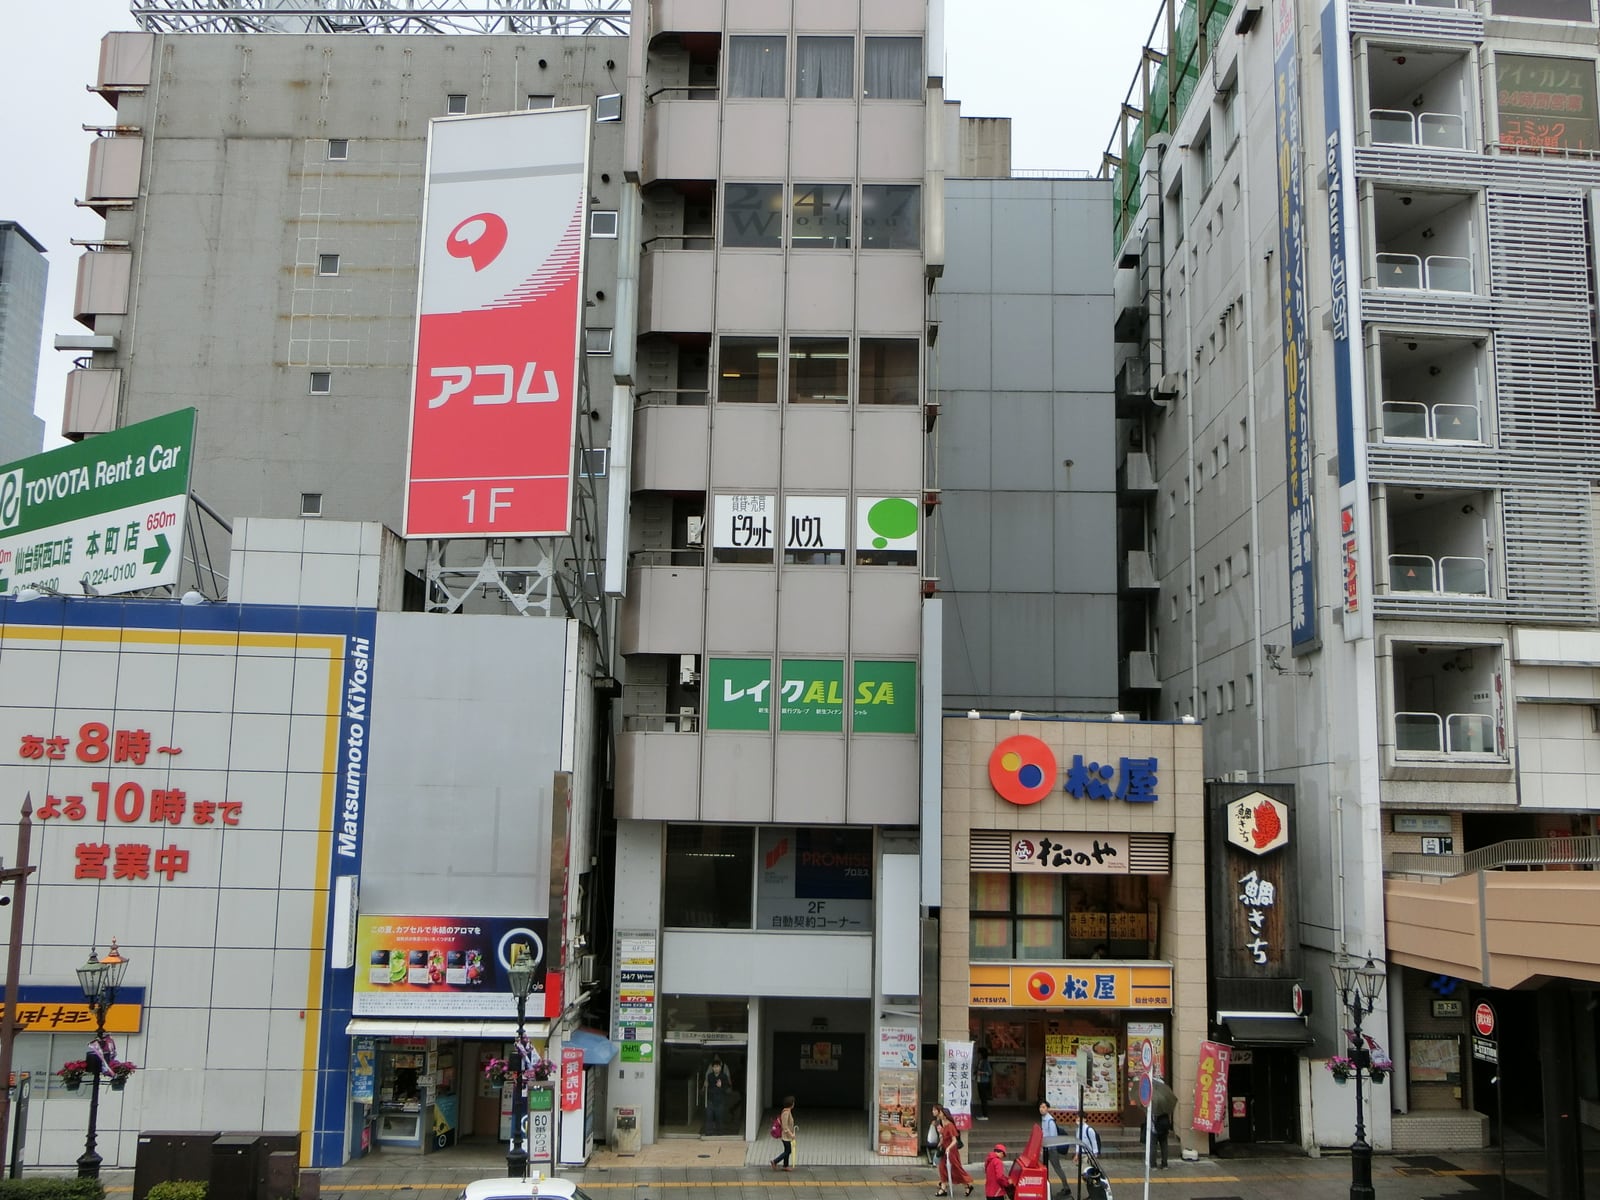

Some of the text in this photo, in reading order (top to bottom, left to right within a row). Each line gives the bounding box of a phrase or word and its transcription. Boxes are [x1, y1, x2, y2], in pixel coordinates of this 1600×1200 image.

[1498, 90, 1584, 111] 24時間営業
[1508, 120, 1566, 137] コミック
[1327, 130, 1339, 174] For
[1330, 254, 1348, 341] JUST
[428, 361, 560, 409] アコム
[25, 444, 181, 507] TOYOTA Rent a Car
[146, 511, 177, 531] 650m
[462, 487, 515, 524] 1F
[86, 520, 141, 560] 本町店
[731, 514, 824, 548] ピタット ハウス
[14, 535, 74, 576] 仙台駅西口店
[91, 561, 137, 586] 224-0100
[1347, 538, 1359, 611] LABI
[338, 636, 371, 858] Matsumoto KiYoshi
[1064, 754, 1159, 803] 松屋
[36, 781, 244, 826] よる10時まで
[74, 842, 190, 881] 営業中
[801, 851, 873, 868] PROMISE
[1036, 837, 1117, 867] 松のや
[843, 868, 870, 877] プロミス
[771, 915, 861, 929] 自動契約コーナー
[808, 901, 826, 914] 2F
[1237, 869, 1277, 965] 鯛きち
[1062, 973, 1116, 1000] 松屋
[1134, 996, 1168, 1004] 仙台中央店
[948, 1061, 958, 1107] 楽天ペイで
[960, 1062, 970, 1107] お支払いは
